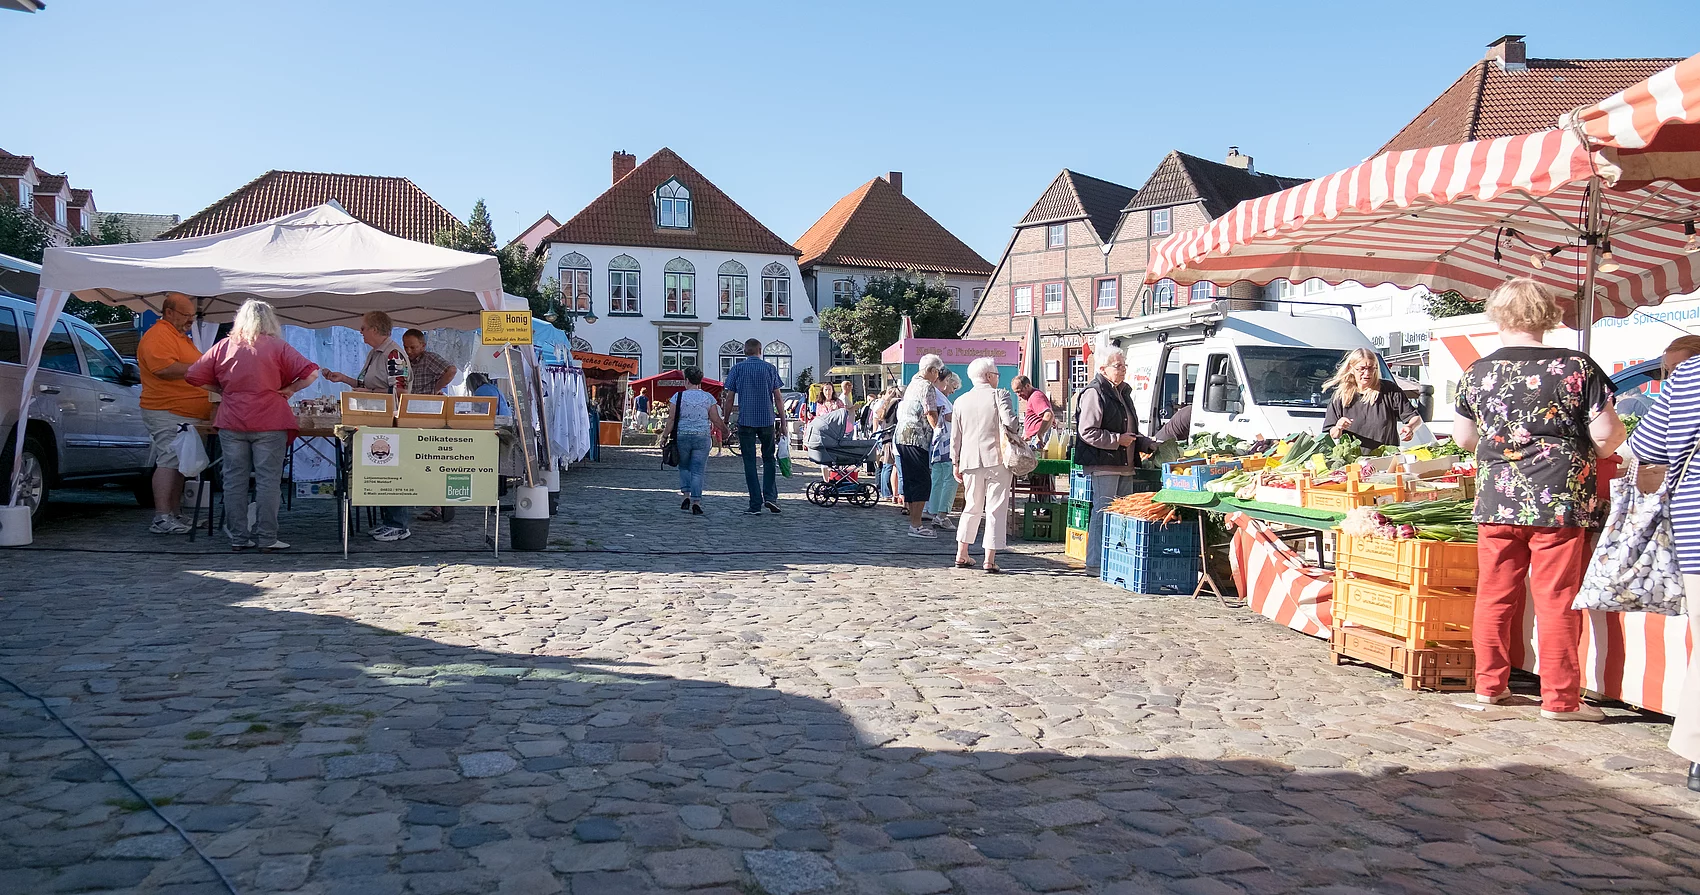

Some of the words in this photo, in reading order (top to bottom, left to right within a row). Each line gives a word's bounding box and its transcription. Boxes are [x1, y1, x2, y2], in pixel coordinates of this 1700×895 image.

[505, 313, 528, 326] Honig
[1050, 337, 1080, 348] MAMA
[955, 347, 1007, 358] Futterluke
[573, 354, 601, 365] Frisches
[603, 358, 635, 369] Geflügel
[417, 435, 474, 443] Delikatessen
[415, 453, 475, 461] Dithmarschen
[438, 465, 476, 473] Gewürze
[447, 485, 470, 497] Brecht
